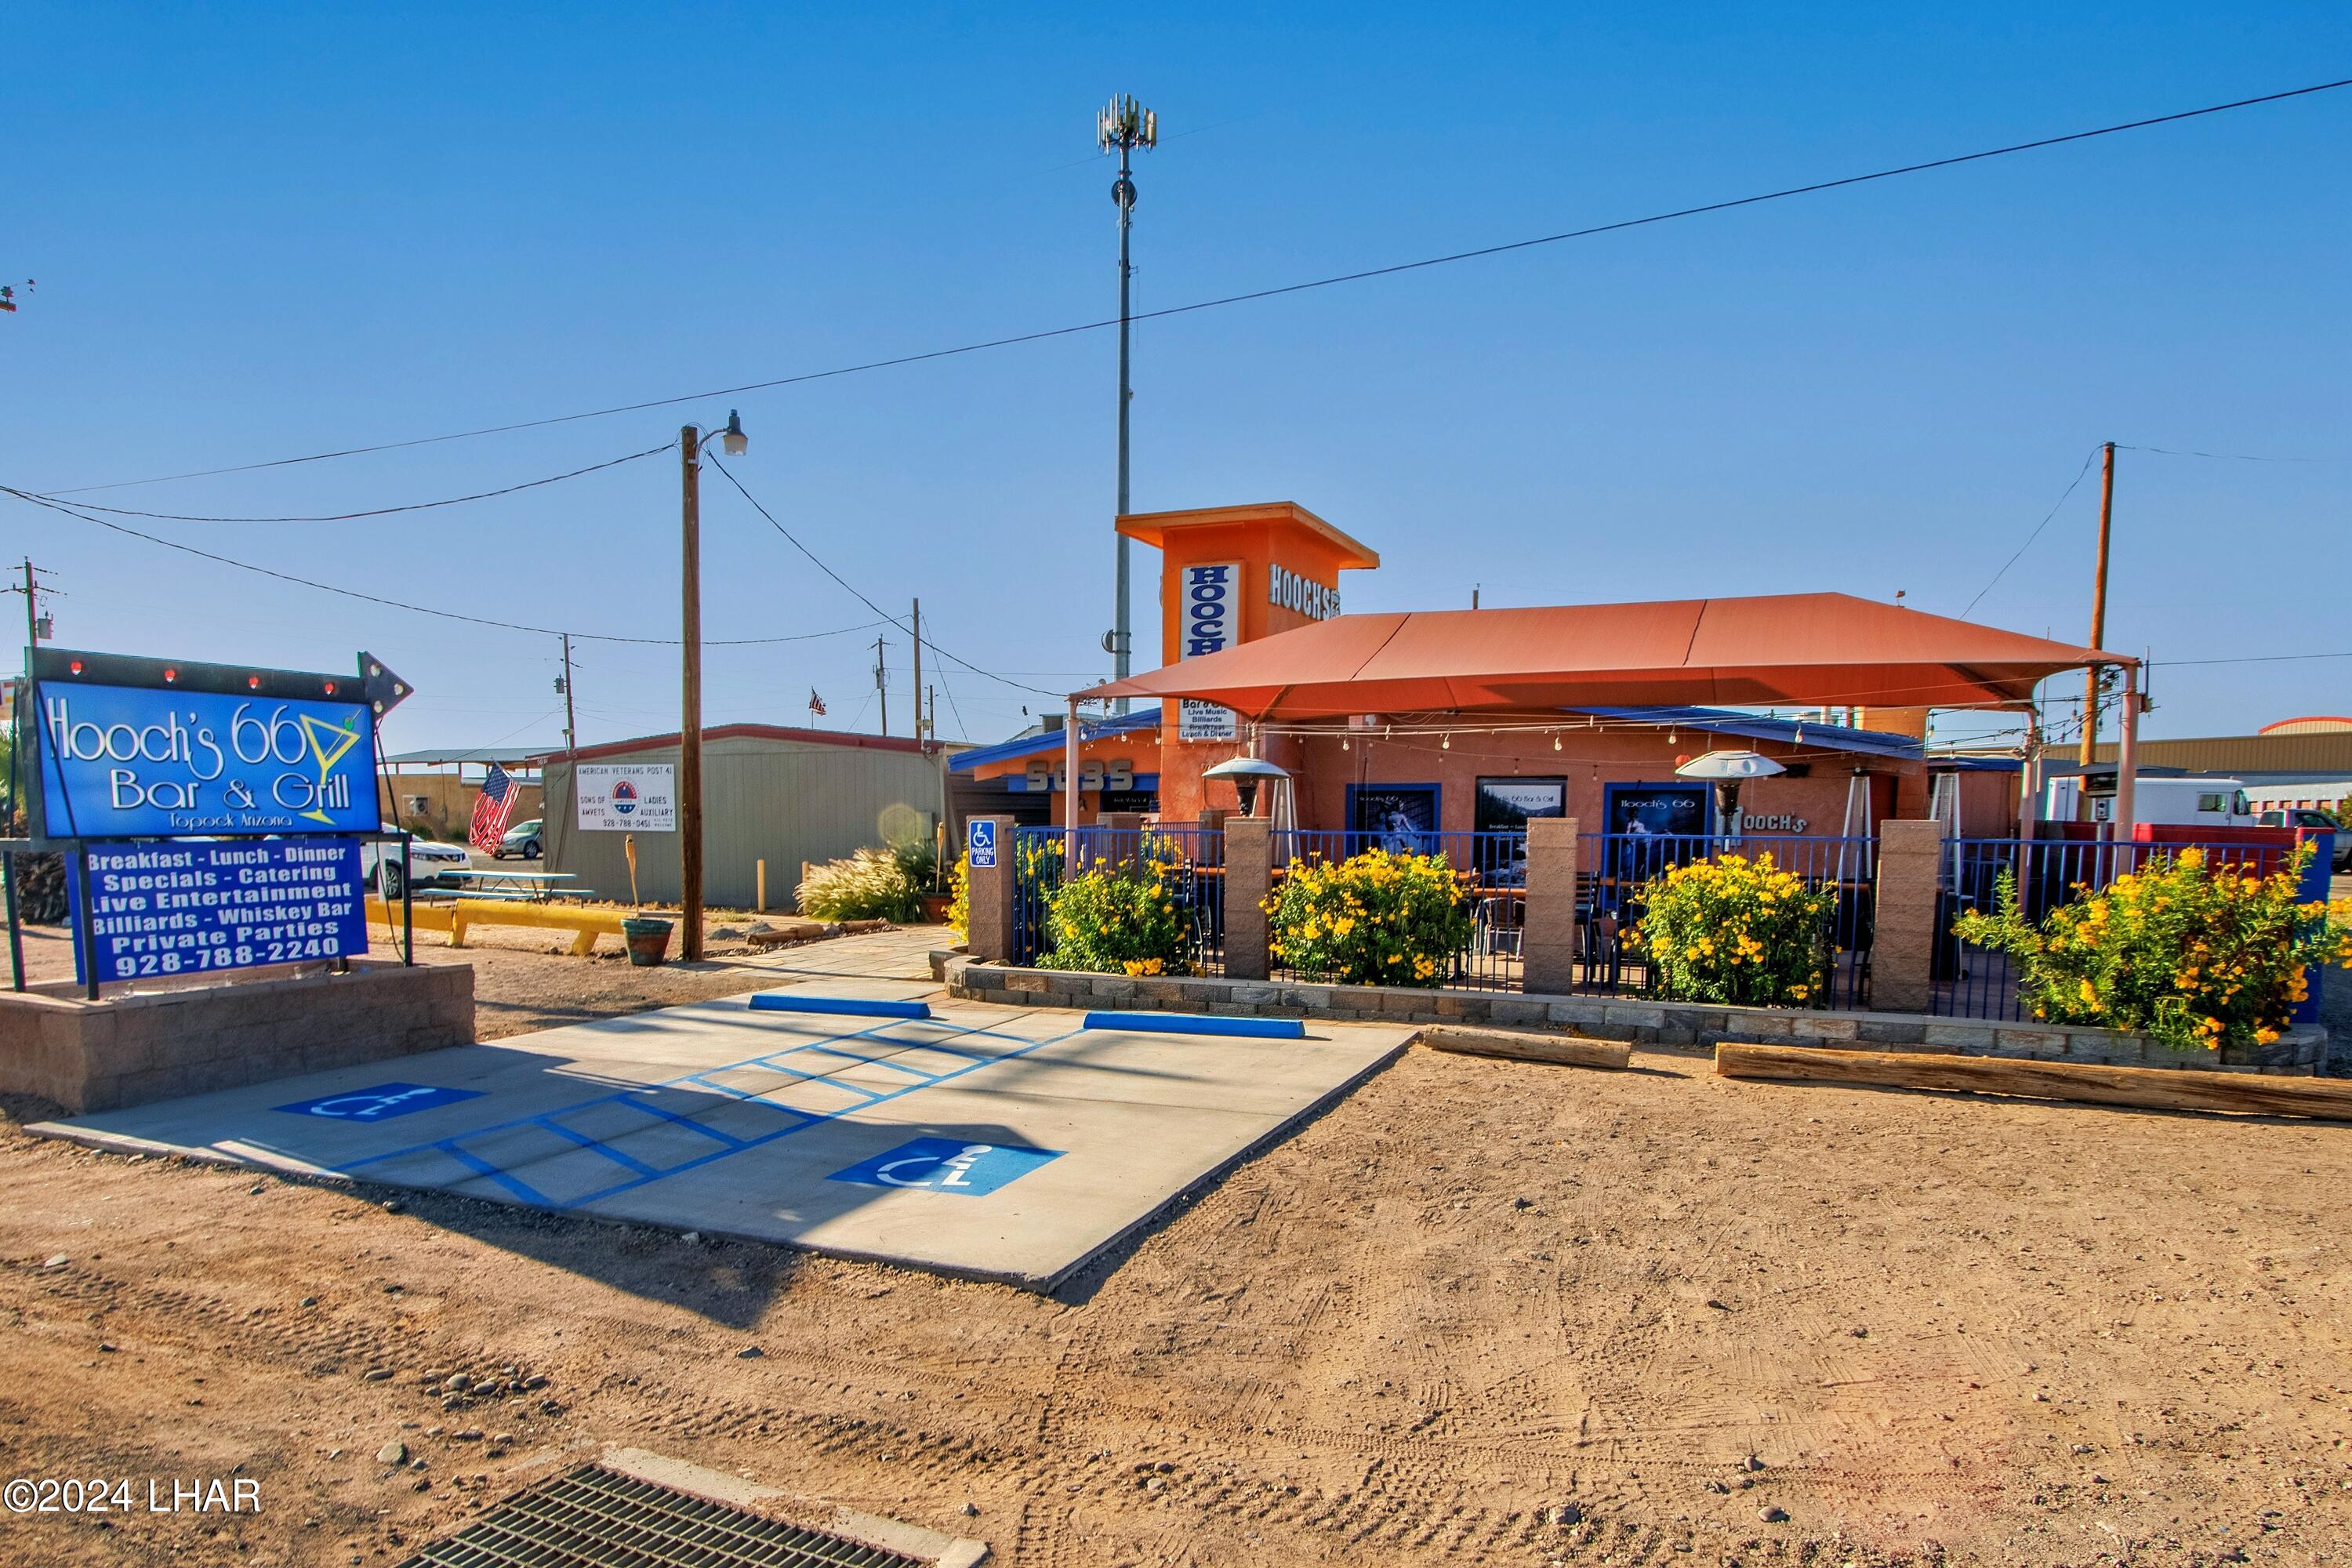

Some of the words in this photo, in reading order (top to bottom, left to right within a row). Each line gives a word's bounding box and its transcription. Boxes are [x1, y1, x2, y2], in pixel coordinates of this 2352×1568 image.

[1269, 564, 1330, 621] HOOCHS
[1187, 566, 1229, 656] HOOCH
[48, 697, 224, 780] Hooch's
[231, 702, 307, 764] 66
[110, 768, 201, 809] Bar
[223, 779, 257, 809] &
[272, 772, 350, 809] Grill
[644, 796, 667, 804] LADIES
[1672, 799, 1695, 808] 66
[169, 812, 234, 832] Topock
[241, 812, 292, 827] Arizona
[603, 818, 651, 828] 928-788-0451
[88, 851, 193, 871] Breakfast
[210, 848, 269, 866] Lunch
[285, 847, 346, 862] Dinner
[972, 847, 994, 856] PARKING
[976, 855, 989, 865] ONLY
[103, 870, 217, 892] Specials
[238, 866, 337, 884] Catering
[92, 896, 147, 914] Live
[156, 882, 352, 909] Entertainment
[93, 913, 198, 936] Billiards
[217, 905, 312, 925] Whiskey
[318, 902, 352, 917] Bar
[112, 931, 227, 954] Private
[236, 921, 339, 942] Parties
[116, 937, 339, 977] 928-788-2240
